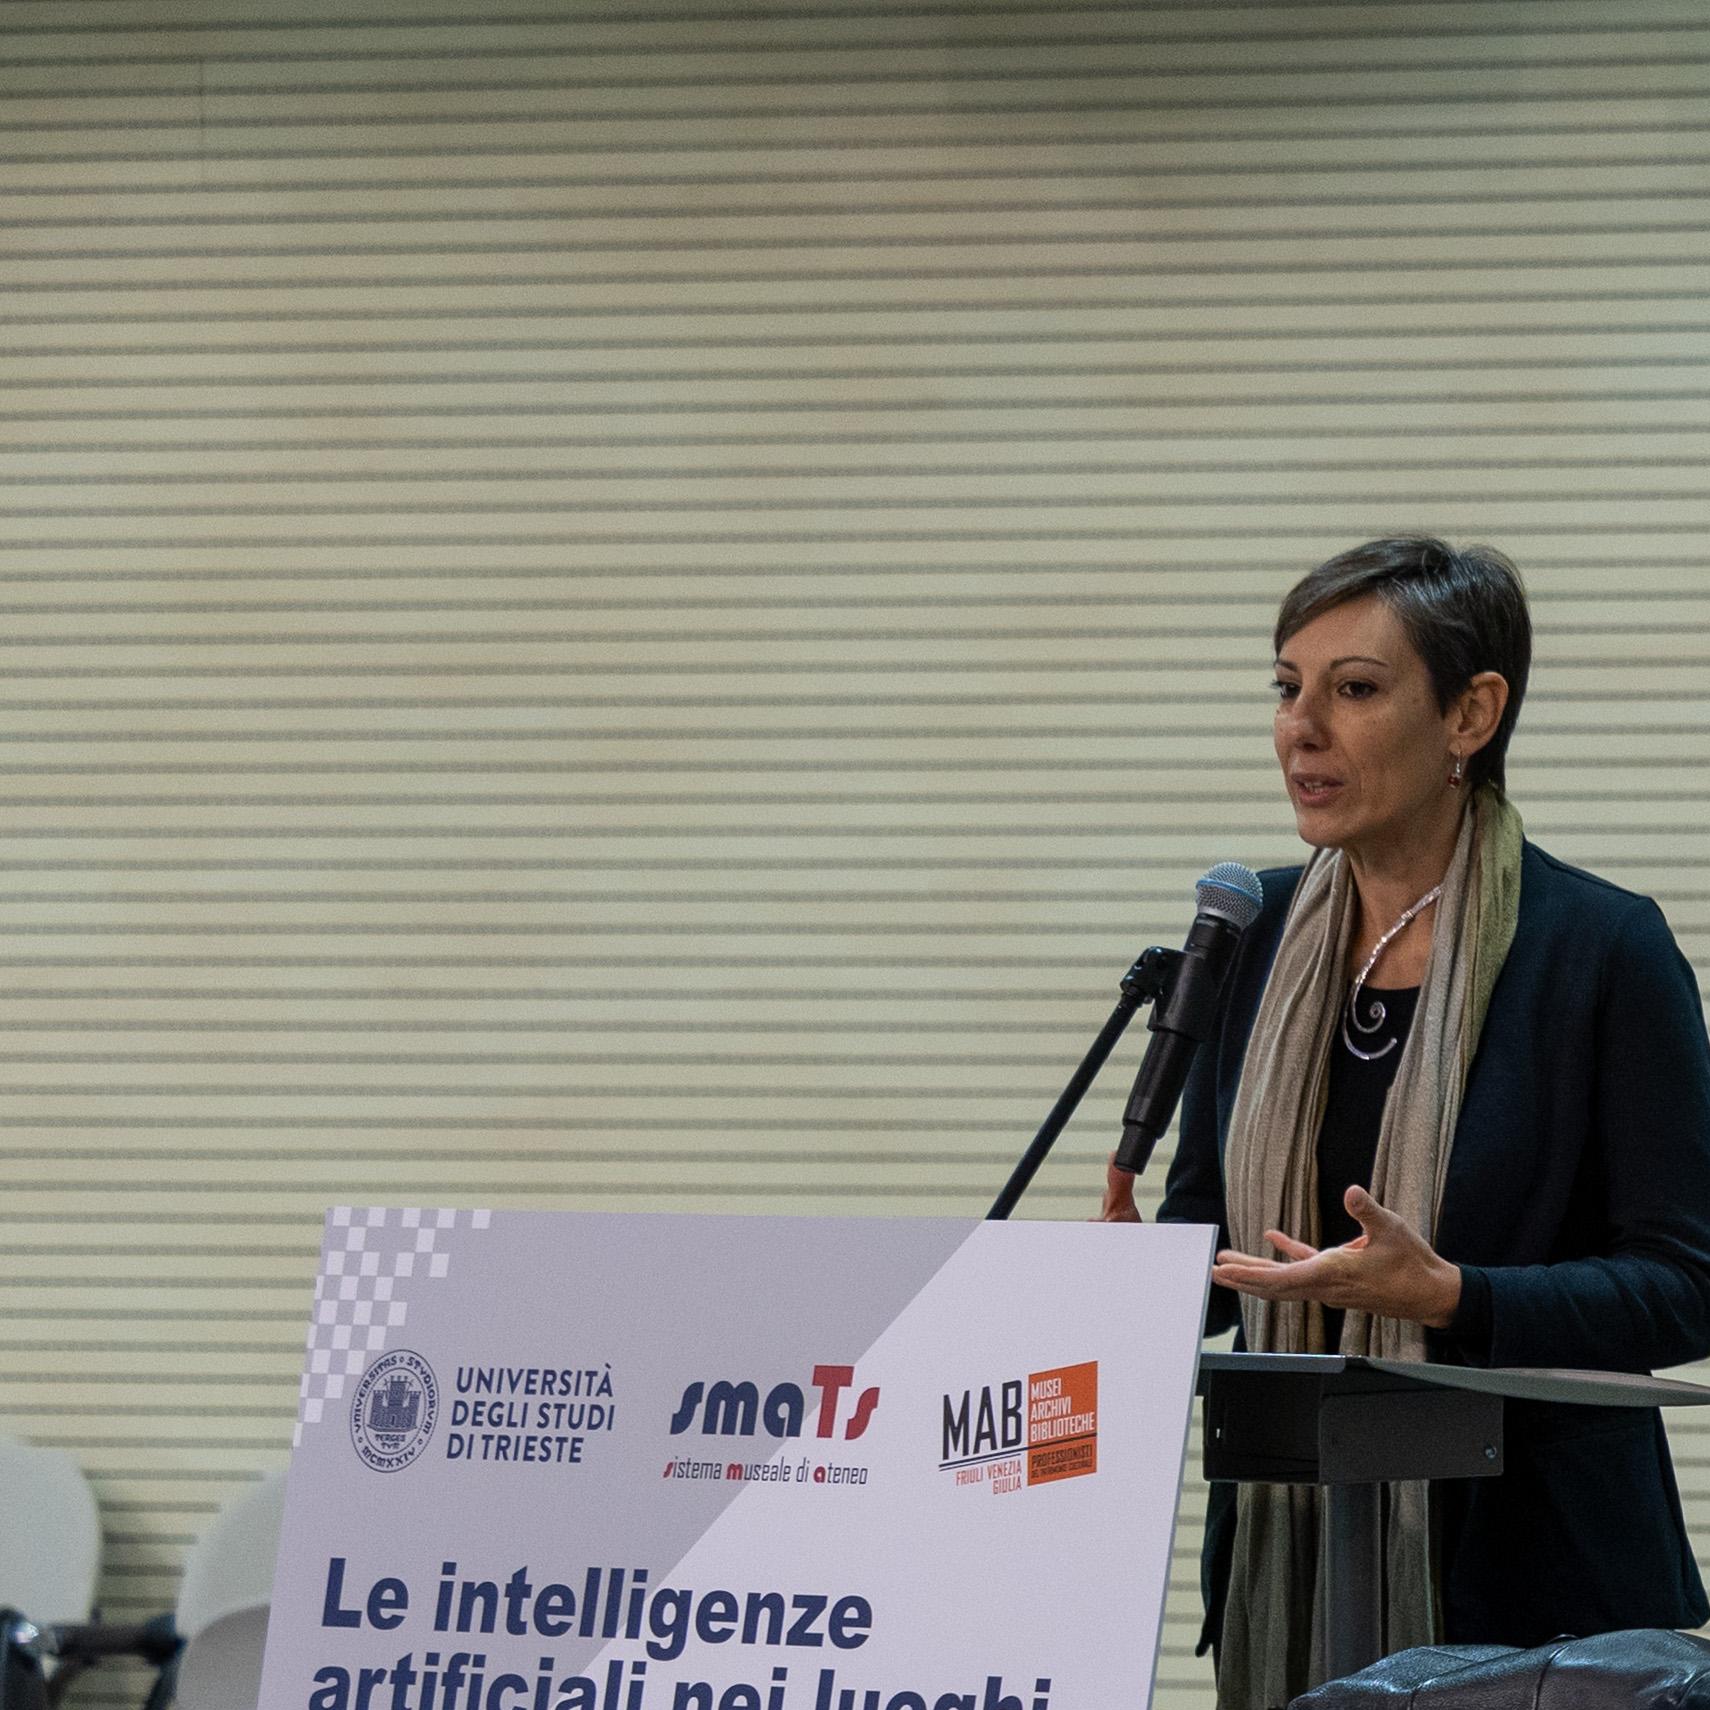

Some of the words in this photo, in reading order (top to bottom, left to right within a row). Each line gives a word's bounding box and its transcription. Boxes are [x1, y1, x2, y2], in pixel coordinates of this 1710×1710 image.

[456, 1362, 613, 1398] UNIVERSITÀ
[1030, 1377, 1062, 1401] MUSEI
[450, 1399, 529, 1428] DEGLI
[536, 1402, 615, 1431] STUDI
[669, 1364, 880, 1440] smaTs
[1030, 1396, 1072, 1422] ARCHIVI
[942, 1379, 1023, 1461] MAB
[1030, 1412, 1096, 1442] BIBLIOTECHE
[446, 1432, 474, 1460] DI
[481, 1433, 584, 1463] TRIESTE
[662, 1455, 722, 1480] sistema
[725, 1455, 792, 1482] museale
[795, 1456, 810, 1483] di
[812, 1462, 868, 1485] ateneo
[956, 1469, 984, 1487] FRIULI
[987, 1460, 1023, 1480] VENEZIA
[992, 1475, 1023, 1495] GIULIA
[321, 1557, 409, 1630] Le
[433, 1561, 873, 1661] intelligenze
